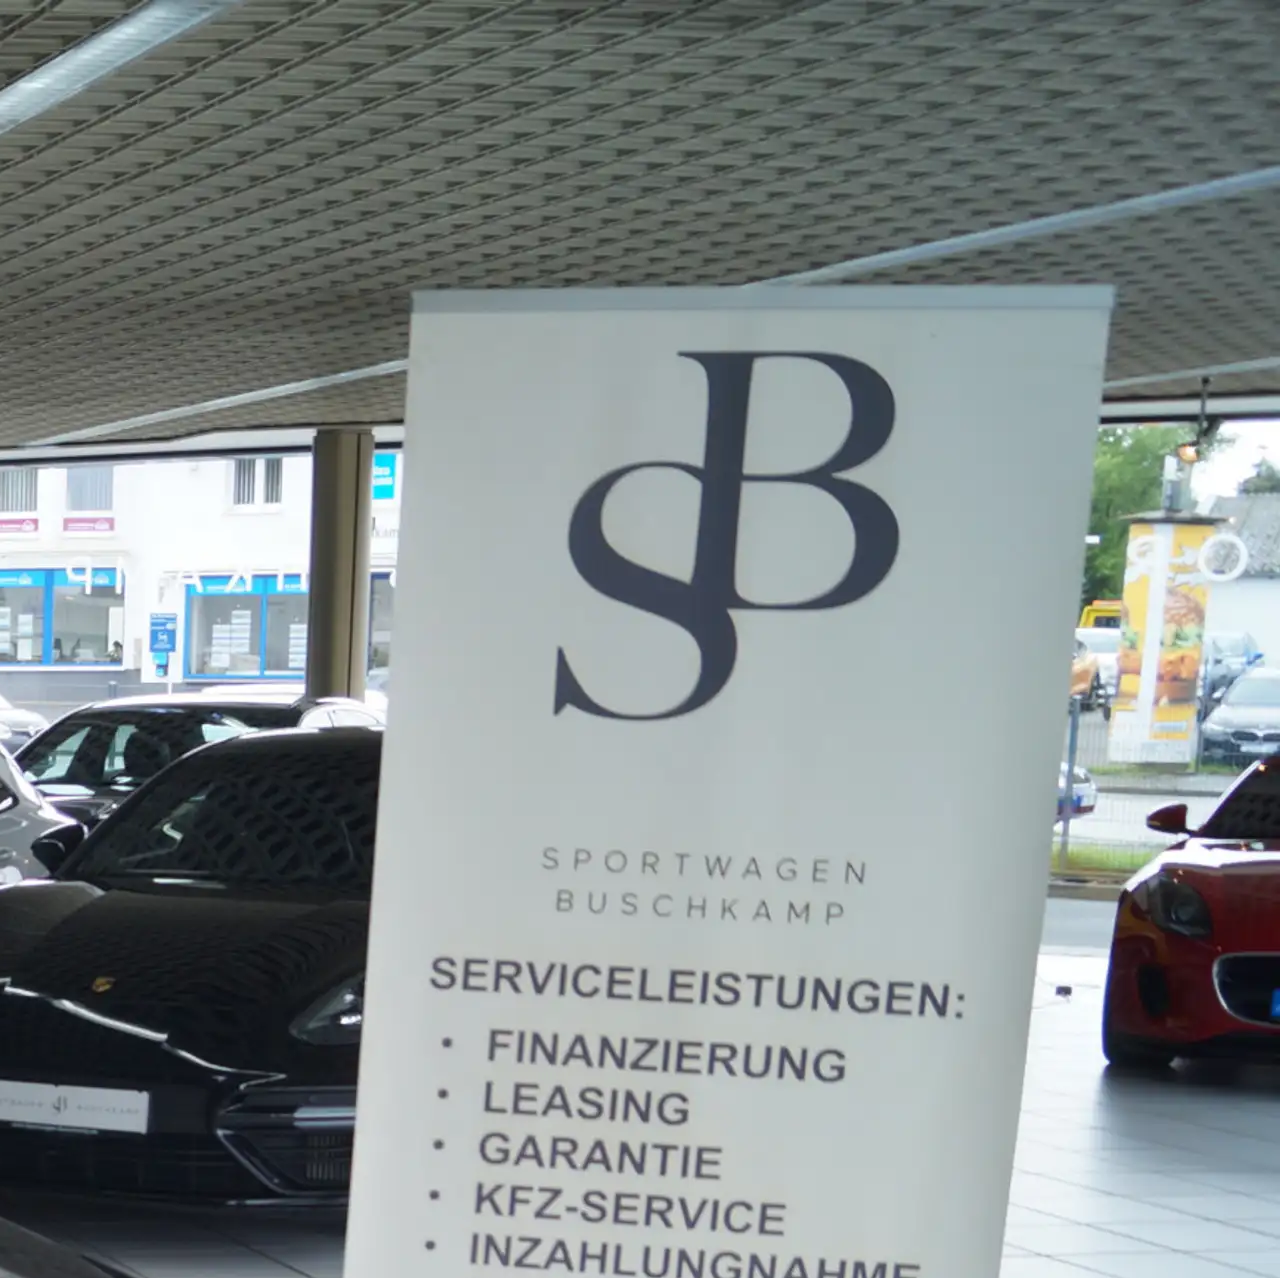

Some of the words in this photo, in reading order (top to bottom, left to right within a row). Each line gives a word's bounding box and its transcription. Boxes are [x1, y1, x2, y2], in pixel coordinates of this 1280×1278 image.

[540, 846, 867, 886] SPORTWAGEN
[554, 888, 845, 927] BUSCHKAMP
[429, 955, 966, 1020] SERVICELEISTUNGEN:
[487, 1028, 846, 1084] FINANZIERUNG
[483, 1080, 690, 1127] LEASING
[478, 1131, 723, 1181] GARANTIE
[474, 1181, 787, 1237] KFZ-SERVICE
